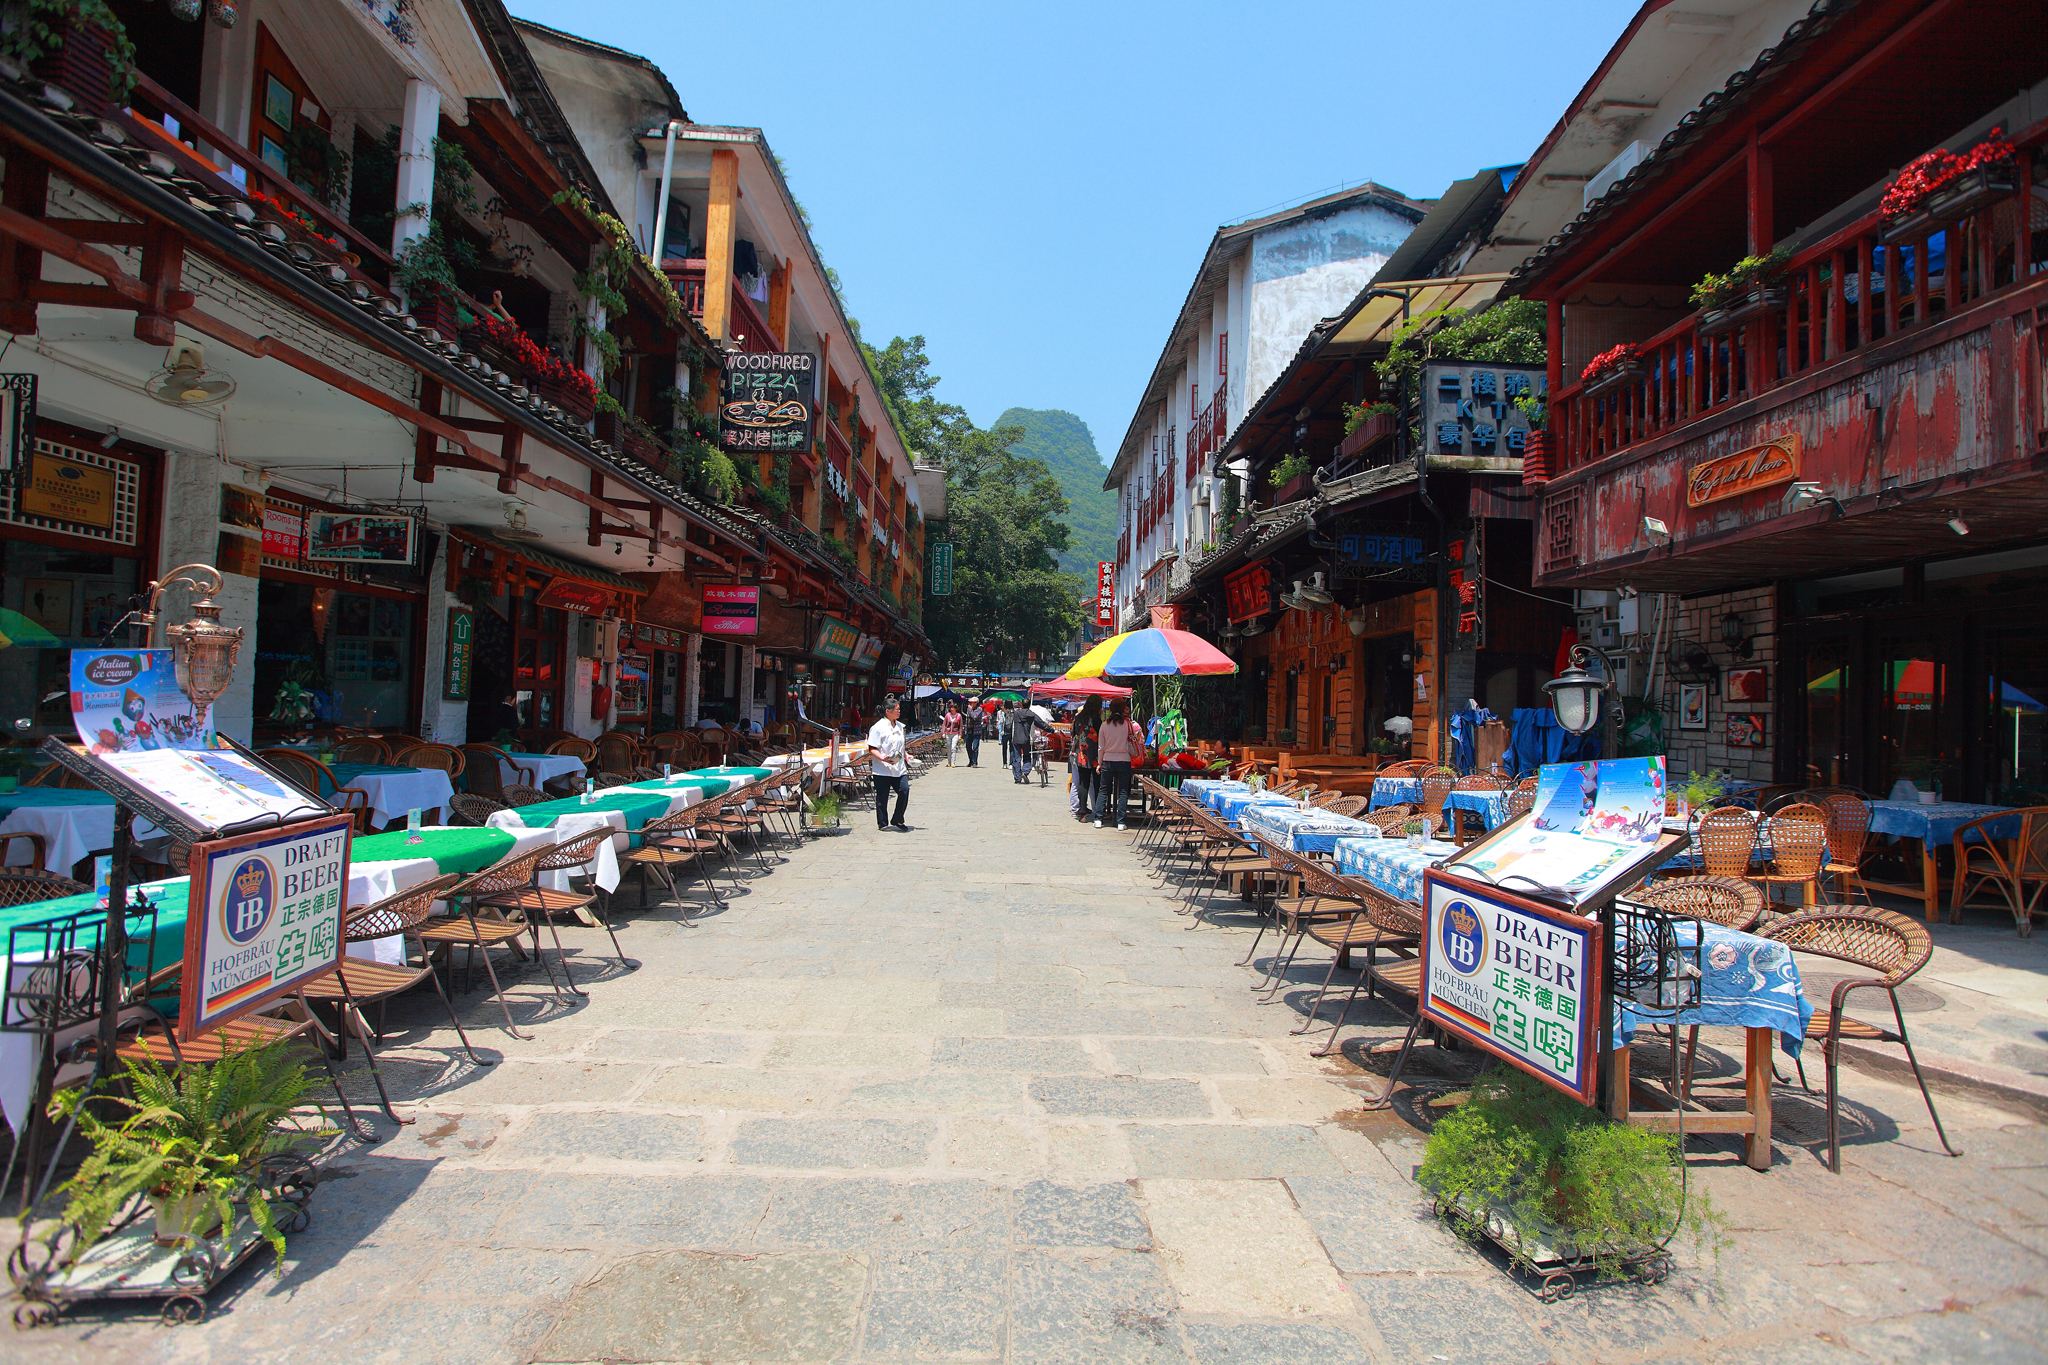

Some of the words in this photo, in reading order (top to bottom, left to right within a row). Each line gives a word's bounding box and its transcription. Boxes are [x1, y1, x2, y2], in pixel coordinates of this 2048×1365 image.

[723, 354, 811, 370] WOODFIRED
[731, 372, 799, 394] PIZZA
[1438, 369, 1547, 396] 二楼雅
[722, 429, 804, 447] 柴火烤比萨
[1693, 467, 1723, 502] Cafe
[1720, 459, 1748, 484] del
[1742, 447, 1787, 479] Moon
[266, 511, 292, 524] Rooms
[1342, 534, 1425, 564] 可可酒吧
[92, 669, 105, 679] ice
[106, 669, 133, 679] cream
[97, 658, 130, 670] Italian
[450, 642, 462, 695] 阳台雅座
[460, 644, 470, 696] BALCONY
[1896, 703, 1932, 711] AIR-CON
[284, 836, 343, 868] DRAFT
[283, 861, 340, 899] BEER
[235, 896, 264, 934] HB
[280, 888, 339, 927] 正宗德国
[274, 916, 335, 980] 生啤
[1450, 931, 1475, 966] HB
[1495, 912, 1578, 959] DRAFT
[211, 938, 275, 976] HOFBRÄU
[1494, 939, 1577, 992] BEER
[210, 957, 274, 995] MÜNCHEN
[1434, 966, 1489, 1003] HOFBRÄU
[1492, 967, 1577, 1021] 正宗德国
[1433, 982, 1489, 1019] MÜNCHEN
[1493, 996, 1575, 1073] 生啤
